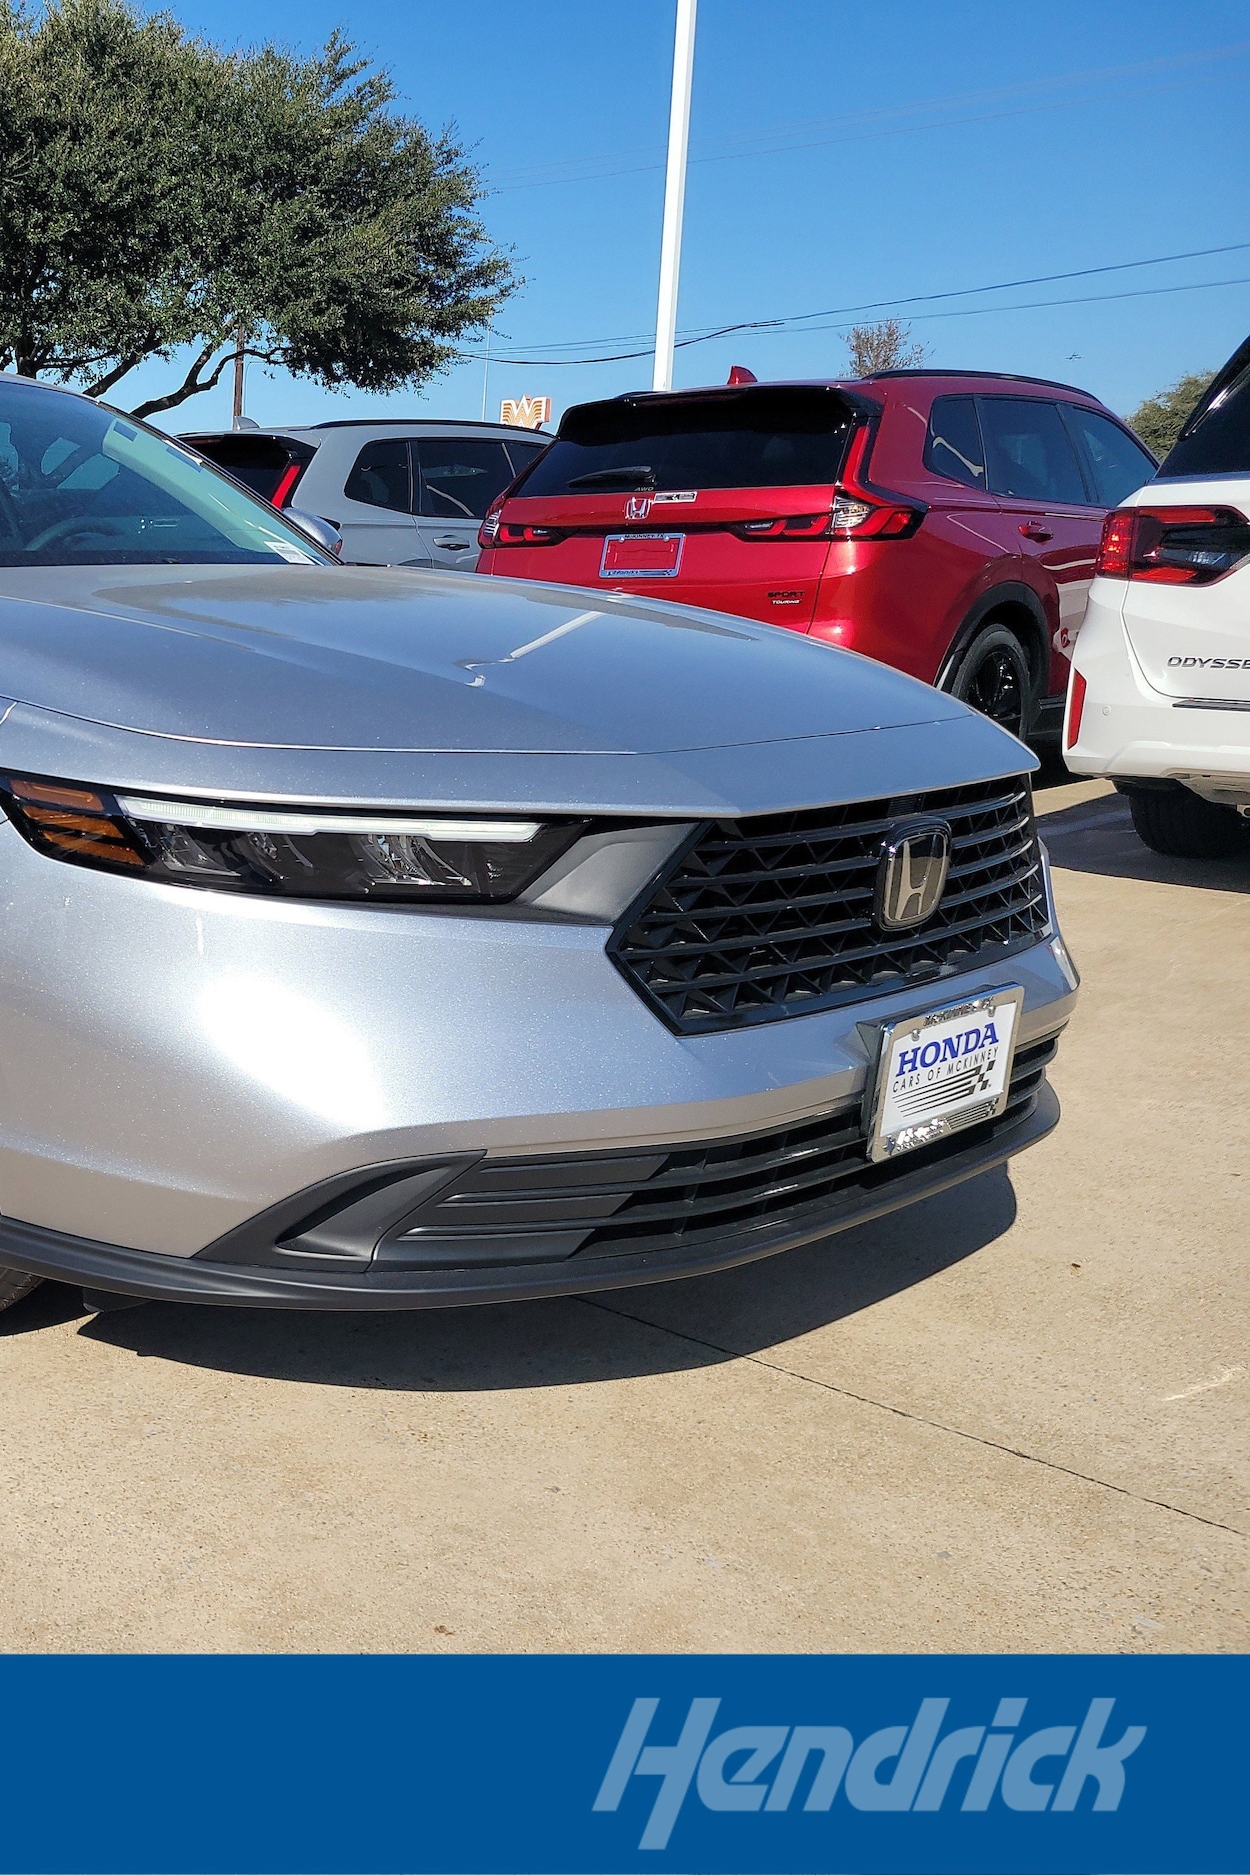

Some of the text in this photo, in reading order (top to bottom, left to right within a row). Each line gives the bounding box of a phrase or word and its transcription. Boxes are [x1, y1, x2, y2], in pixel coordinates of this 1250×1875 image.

[1167, 656, 1250, 670] ODYSSE
[892, 1046, 999, 1093] CARS OF MCKINNEY
[896, 1022, 999, 1077] HONDA
